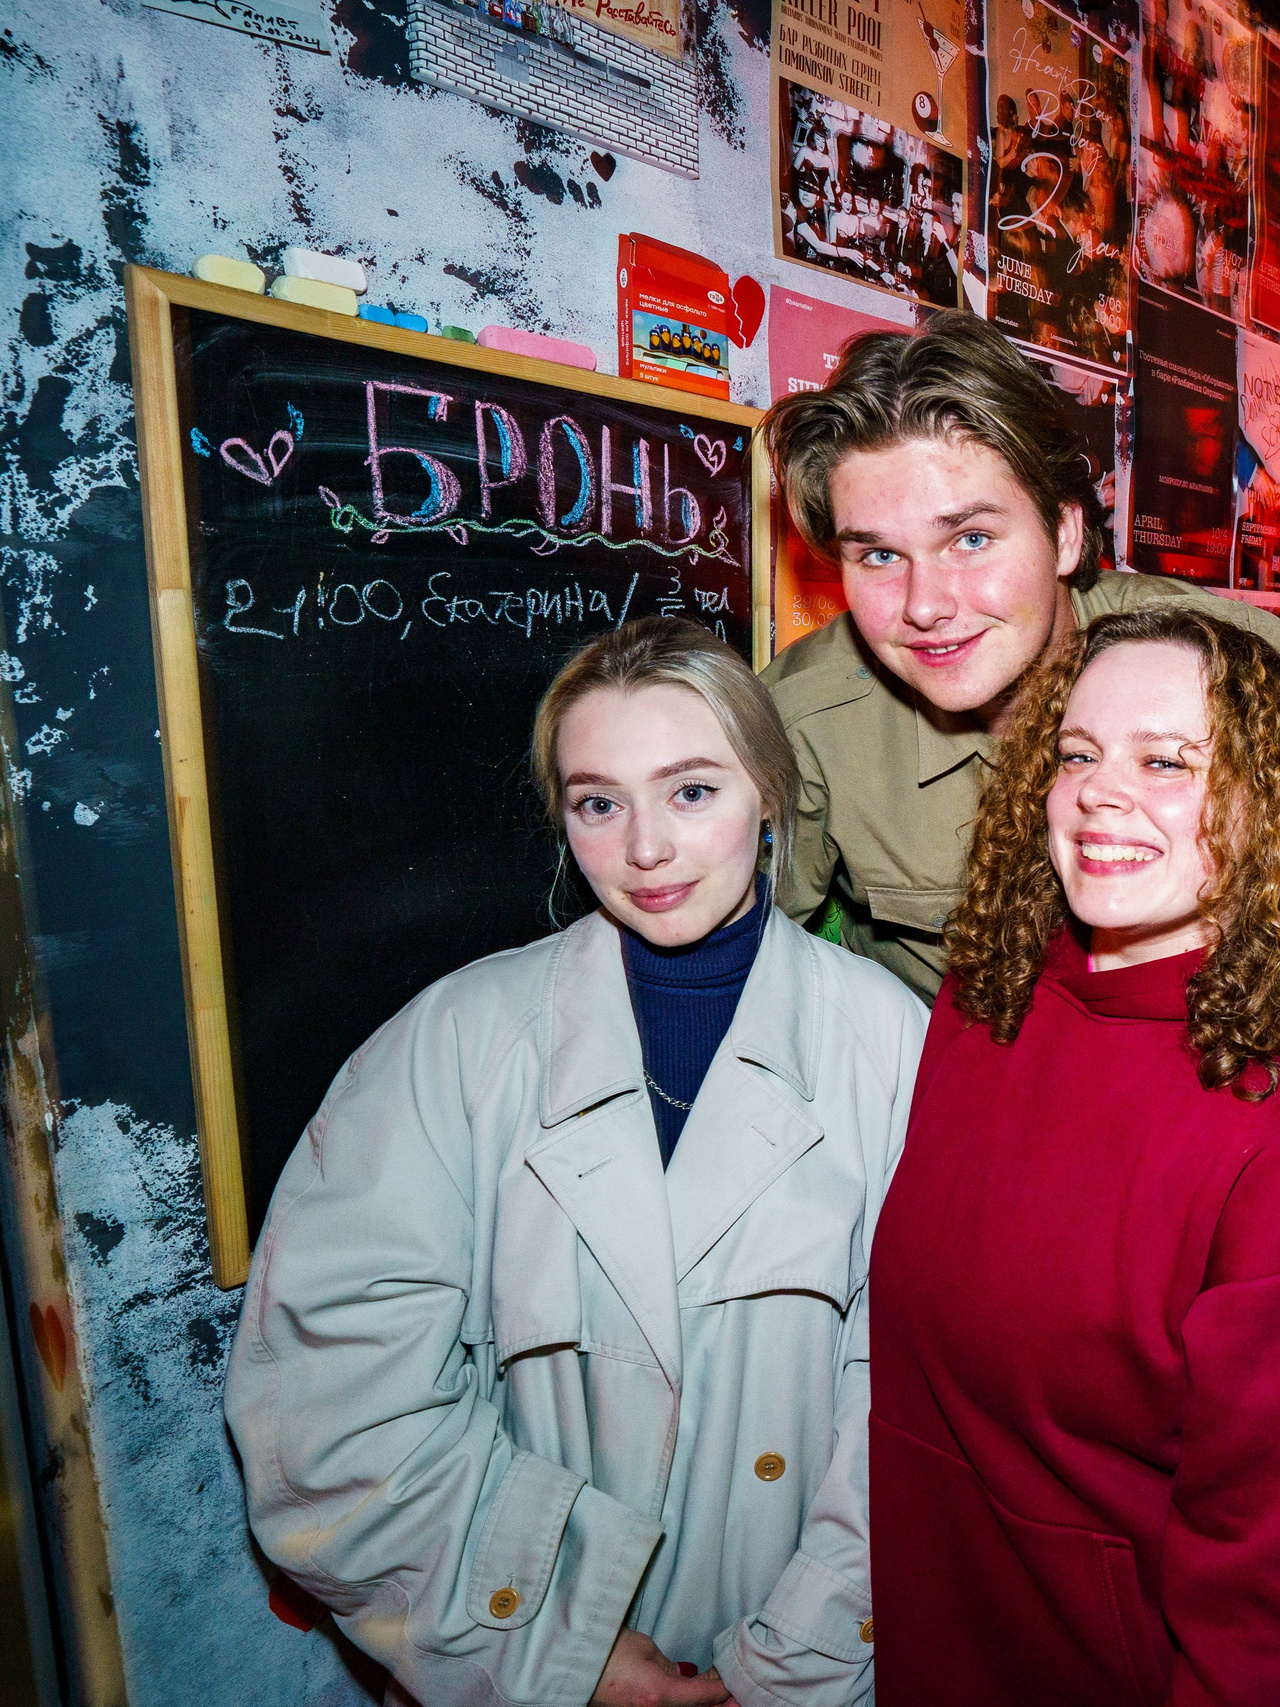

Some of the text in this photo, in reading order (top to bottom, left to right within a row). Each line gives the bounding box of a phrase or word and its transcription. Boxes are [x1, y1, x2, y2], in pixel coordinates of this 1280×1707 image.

[847, 5, 883, 51] POOL
[780, 23, 882, 87] БАР РАЗБИТЫХ СЕРДЕЦ
[779, 45, 881, 107] LOMONOSOV STREET, 1
[918, 96, 926, 109] 8
[1068, 79, 1113, 124] Bar
[997, 152, 1057, 238] 2
[997, 254, 1032, 280] JUNE
[996, 272, 1053, 306] TUESDAY
[639, 293, 661, 304] мелки
[663, 299, 675, 308] для
[676, 303, 707, 318] асфальта
[639, 301, 669, 313] цветные
[1098, 293, 1122, 314] 3/06
[1094, 308, 1121, 330] 19:00
[639, 363, 667, 374] мультики
[1138, 349, 1169, 368] Гостевая
[644, 374, 660, 382] штук
[1151, 369, 1156, 377] в
[1156, 368, 1171, 383] баре
[1244, 373, 1272, 402] NOT
[362, 380, 702, 544] БРОНЬ
[1134, 514, 1163, 530] APRIL
[1242, 521, 1277, 536] SEPTEMBER
[1133, 530, 1182, 549] THURSDAY
[1206, 541, 1227, 555] 19:00
[1241, 534, 1263, 546] FRIDAY
